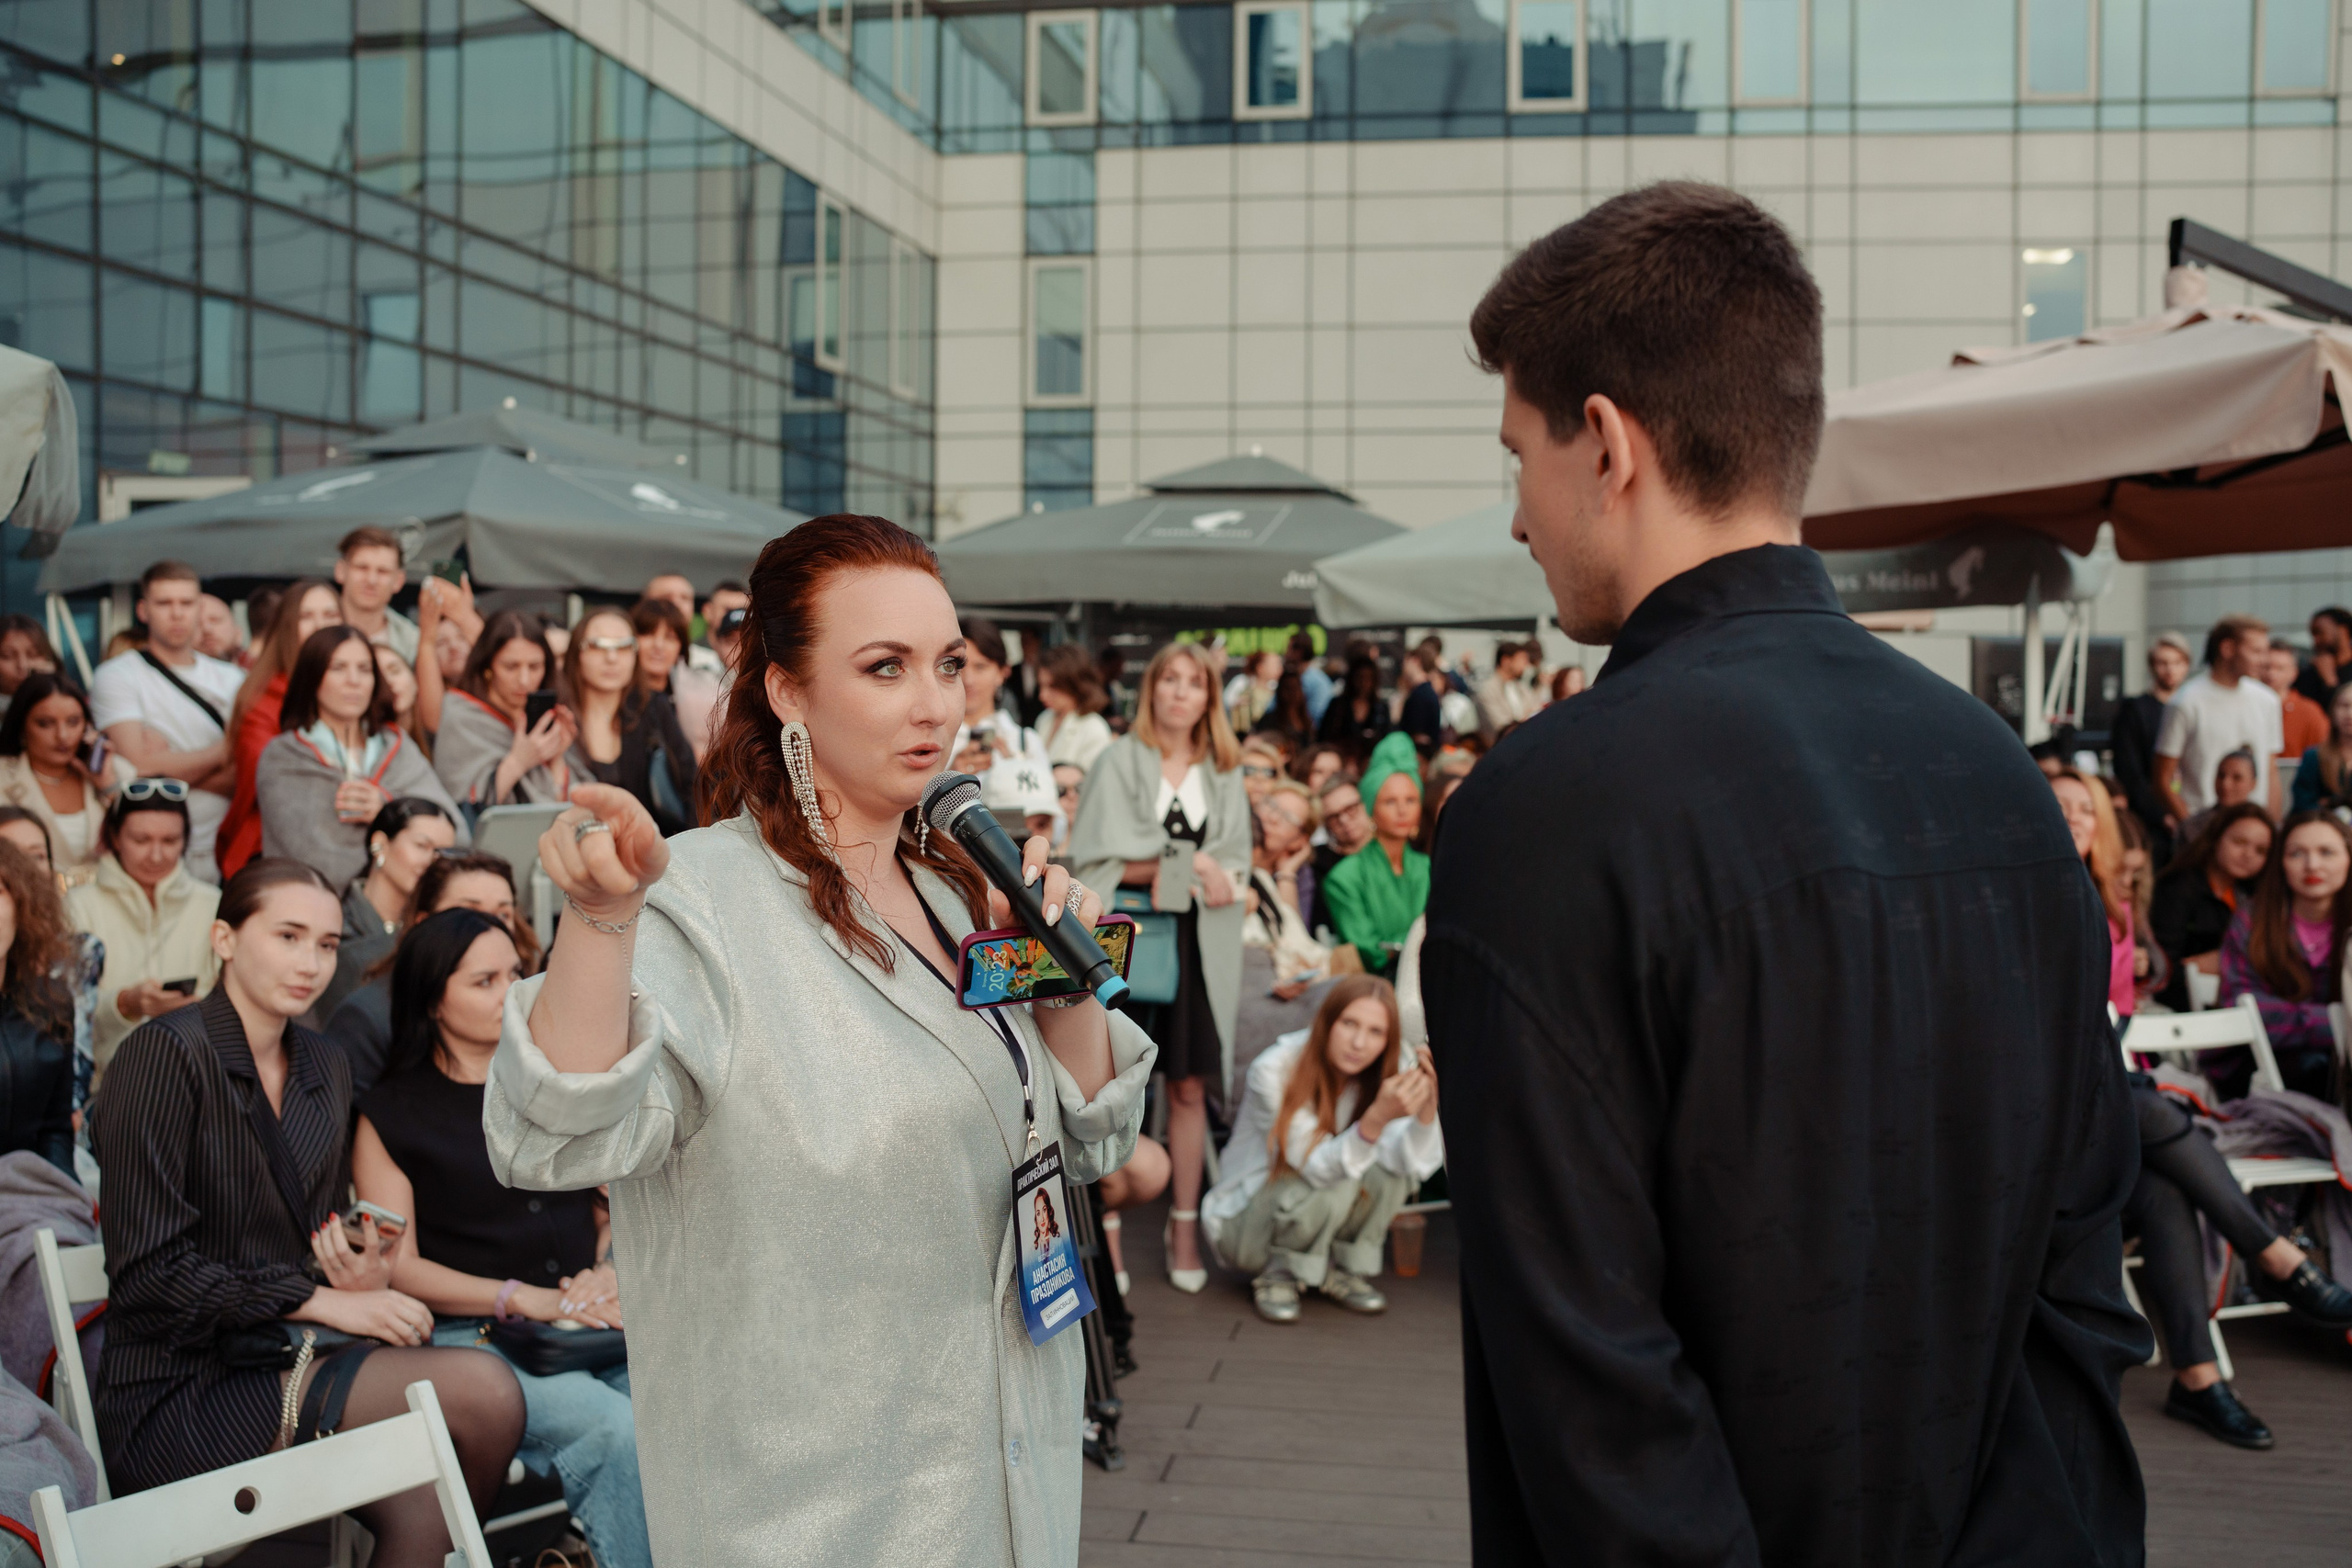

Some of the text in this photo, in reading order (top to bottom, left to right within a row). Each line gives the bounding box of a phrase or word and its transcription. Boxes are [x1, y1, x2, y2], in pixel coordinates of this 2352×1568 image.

[989, 950, 1008, 991] 20:23
[1030, 1267, 1076, 1304] ПРАЗДНИКОВА
[1032, 1253, 1067, 1285] АНАСТАСИЯ
